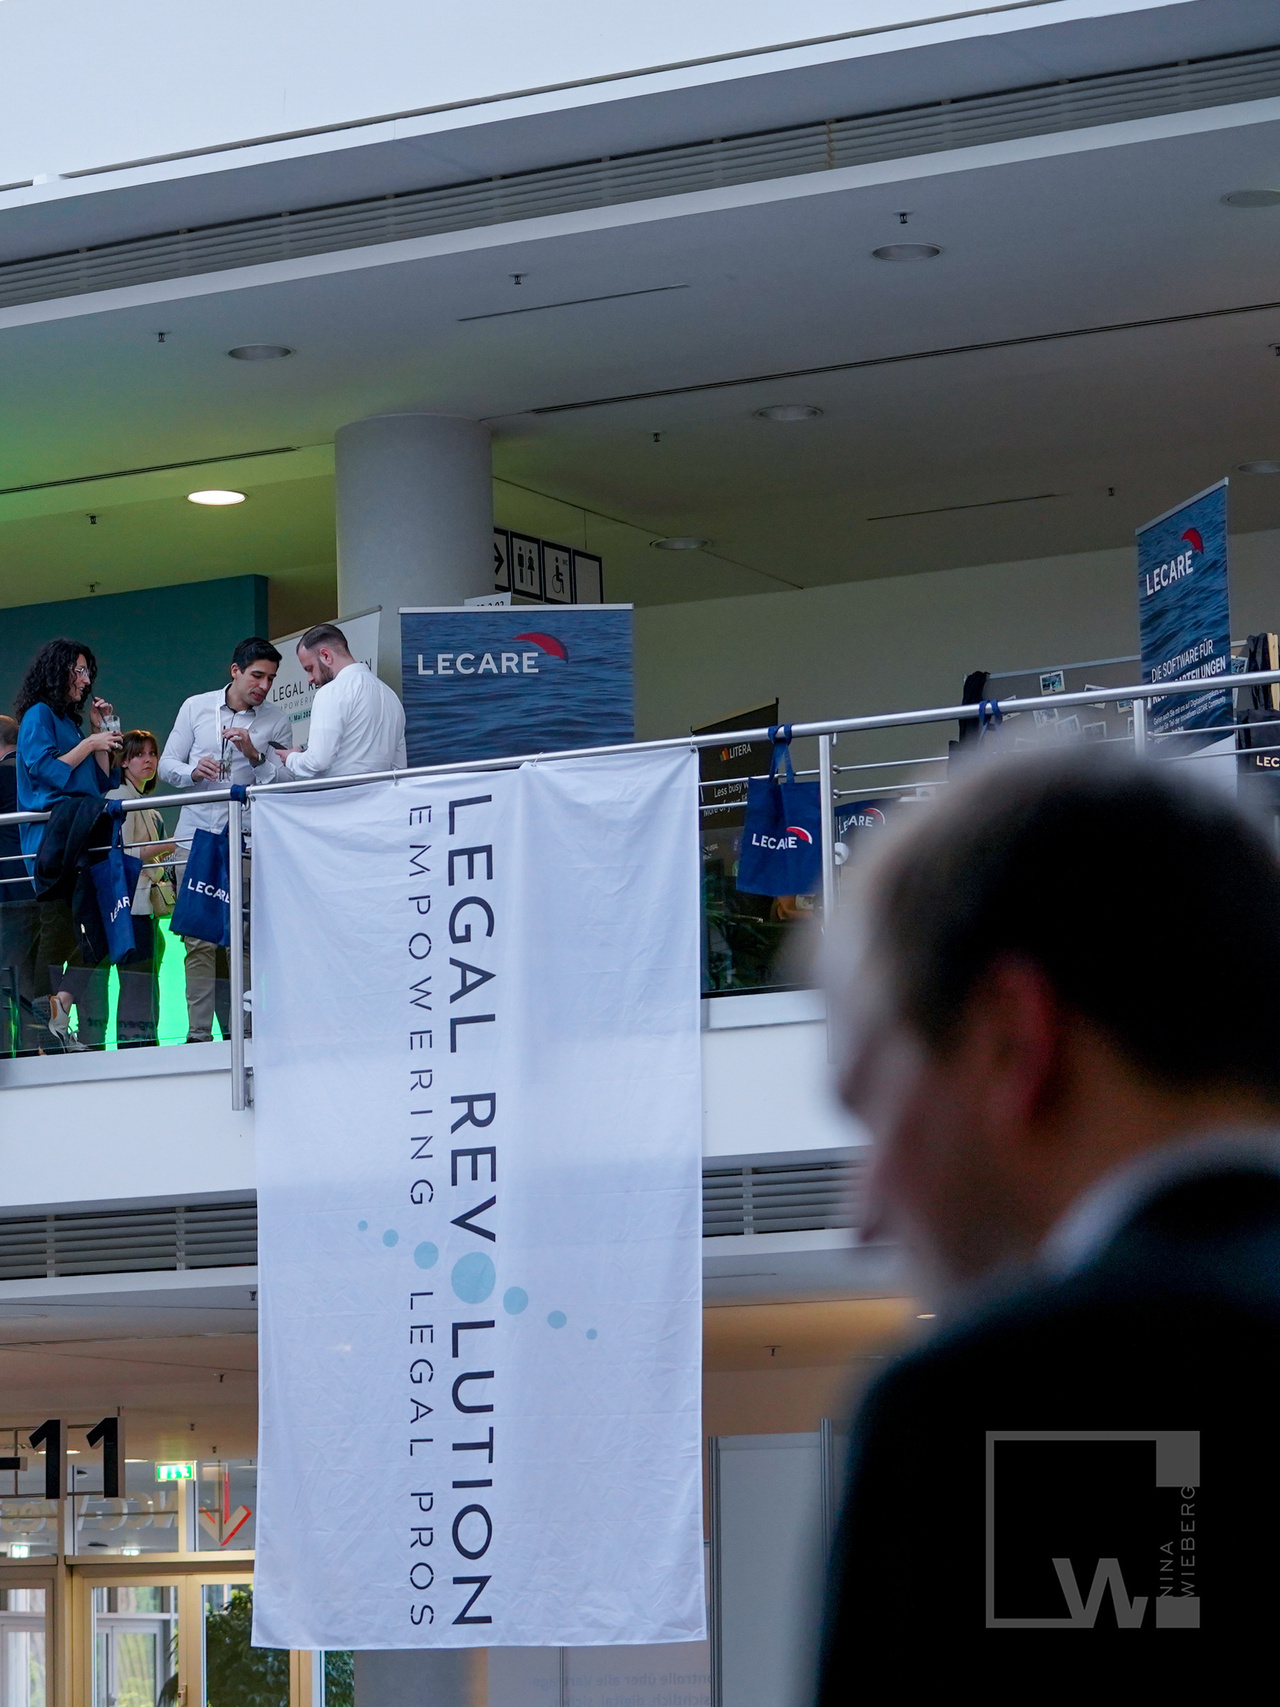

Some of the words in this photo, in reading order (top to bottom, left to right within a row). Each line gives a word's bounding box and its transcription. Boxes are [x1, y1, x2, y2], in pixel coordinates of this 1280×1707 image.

[1146, 550, 1194, 596] LECARE
[418, 651, 540, 676] LECARE
[1151, 665, 1162, 683] DIE
[1162, 646, 1199, 677] SOFTWARE
[1199, 638, 1214, 659] FÜR
[272, 681, 304, 703] LEGAL
[729, 743, 752, 759] LITERA
[713, 786, 727, 798] Less
[728, 782, 742, 794] busy
[448, 794, 497, 1053] LEGAL
[408, 805, 434, 1205] EMPOWERING
[410, 1291, 434, 1457] LEGAL
[410, 1492, 434, 1626] PROS
